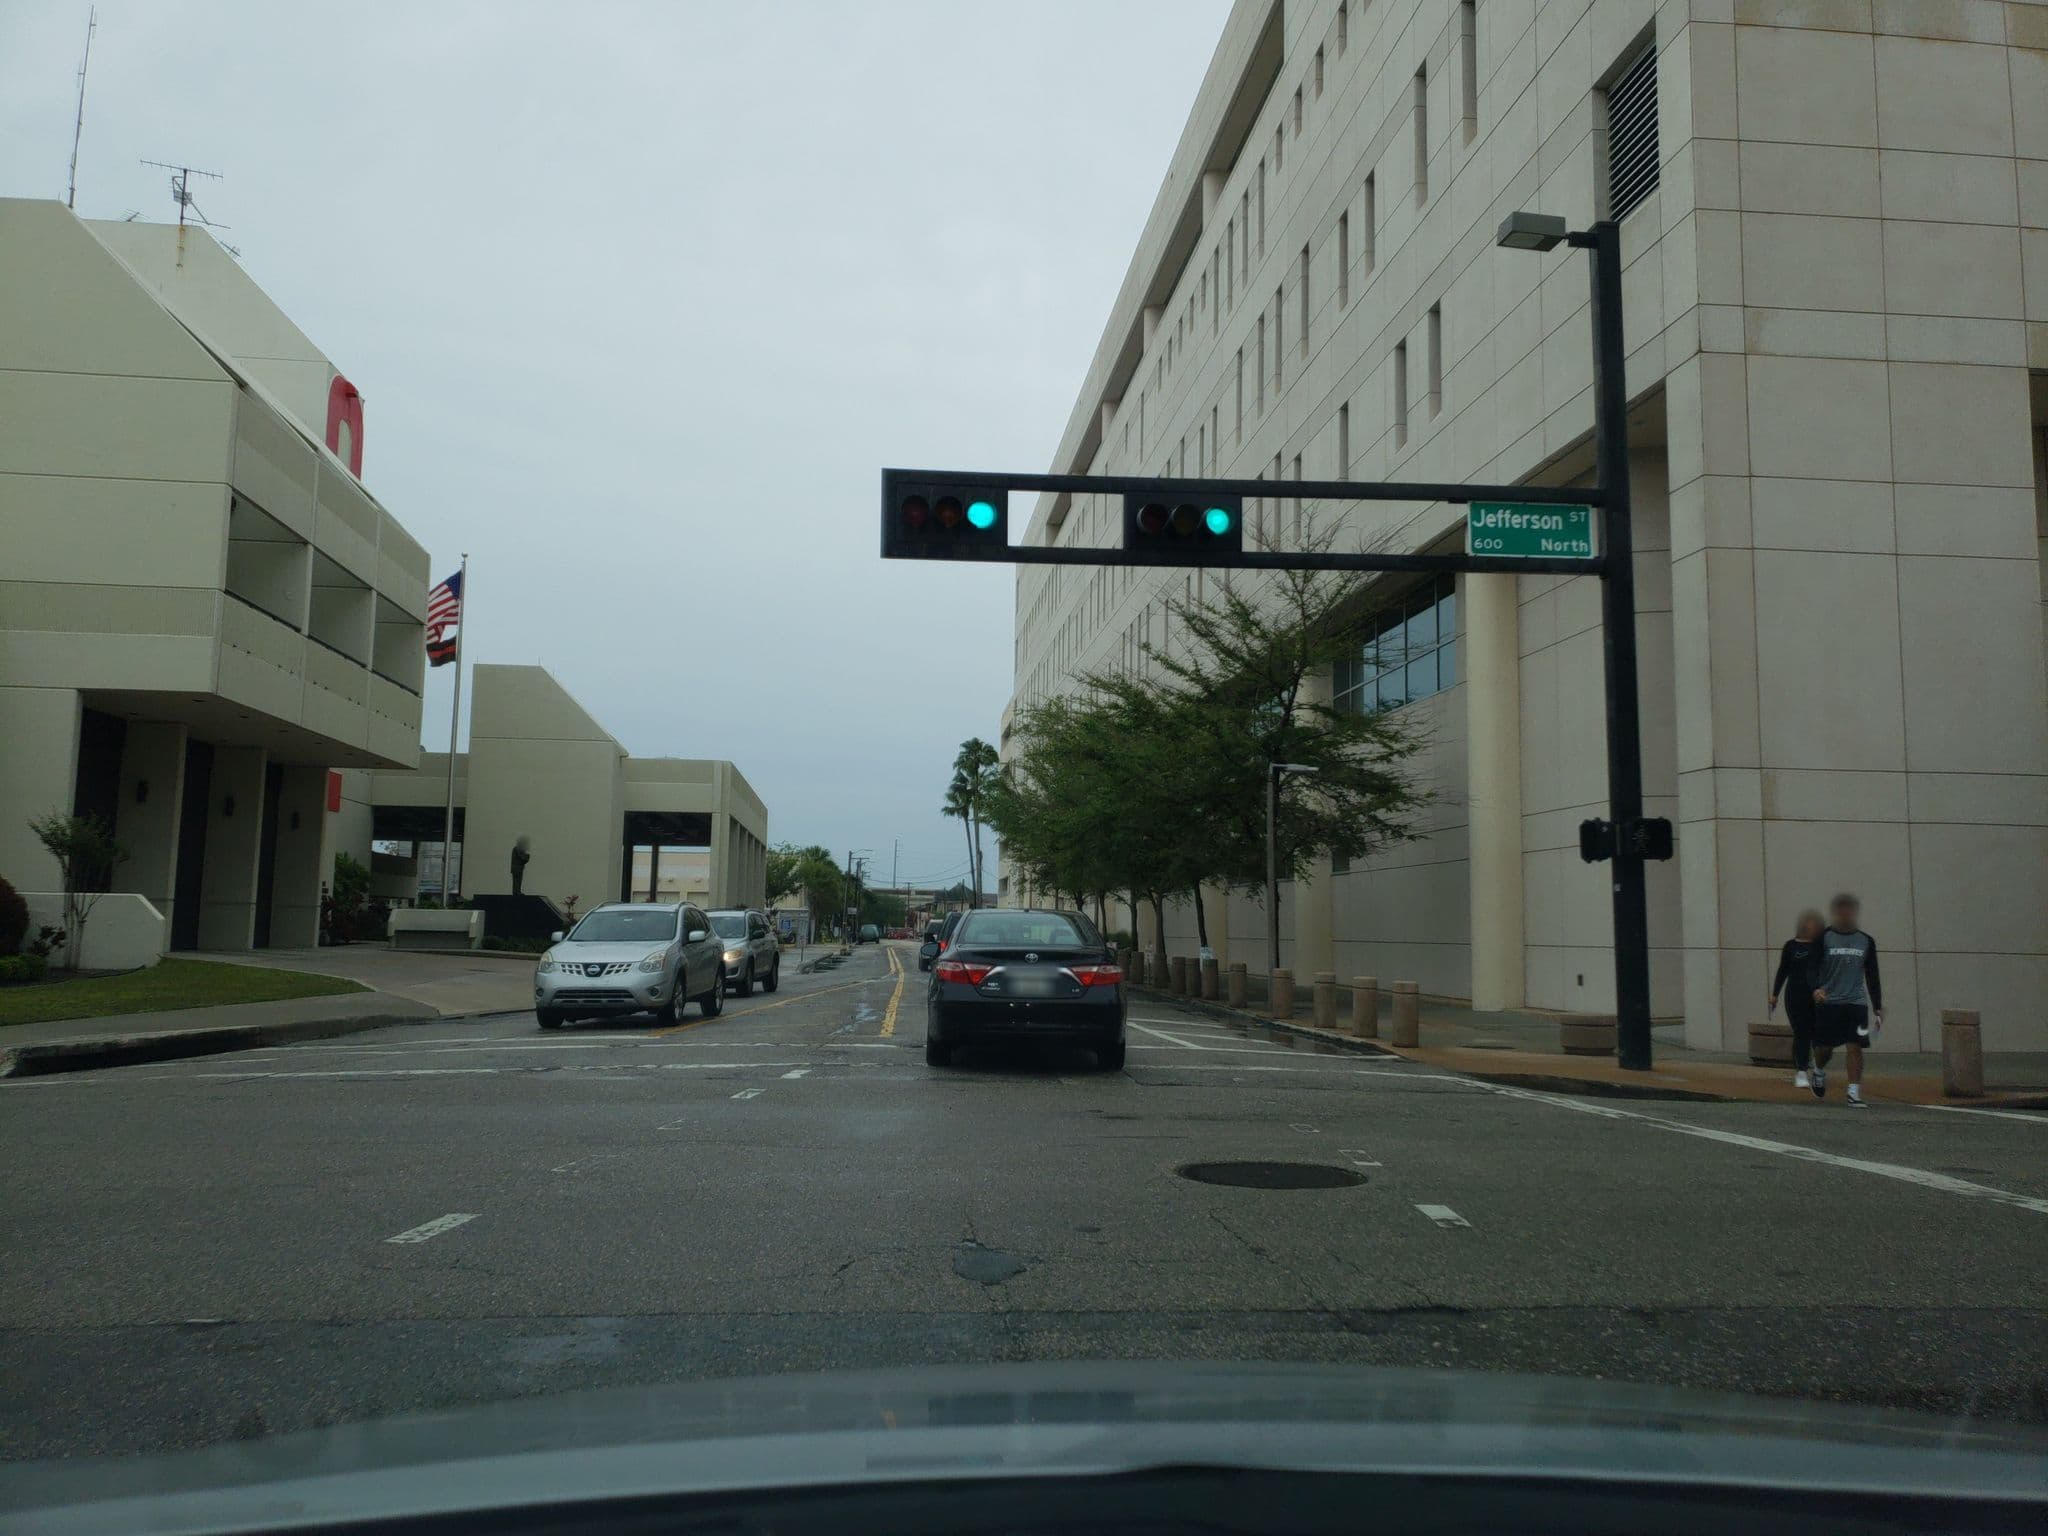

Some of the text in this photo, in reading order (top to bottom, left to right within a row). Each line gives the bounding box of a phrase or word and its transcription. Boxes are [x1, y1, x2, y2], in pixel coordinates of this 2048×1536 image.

[1471, 508, 1586, 530] Jefferson ST
[1473, 538, 1588, 553] 600 North
